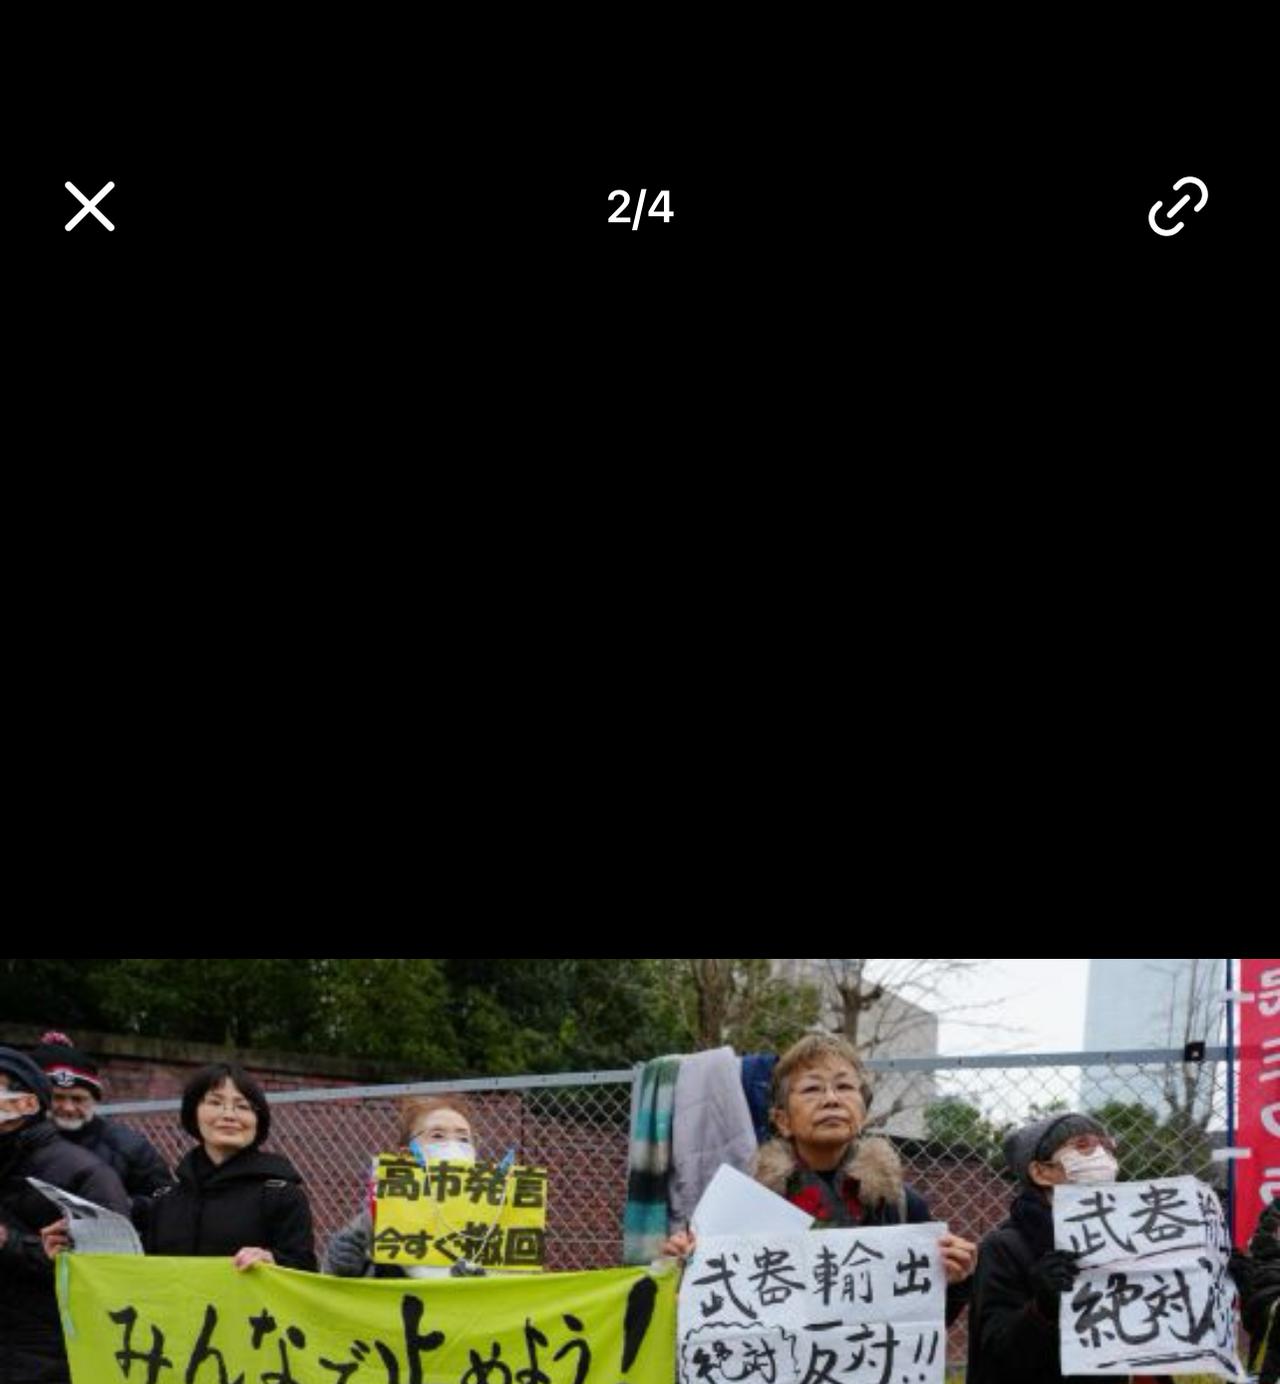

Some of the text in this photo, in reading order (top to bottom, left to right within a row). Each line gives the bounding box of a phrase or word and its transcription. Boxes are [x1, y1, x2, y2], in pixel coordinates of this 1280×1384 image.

[374, 1158, 548, 1208] 高市発言
[373, 1221, 546, 1265] 今すぐ撤回
[693, 1240, 932, 1320] 武器輸出
